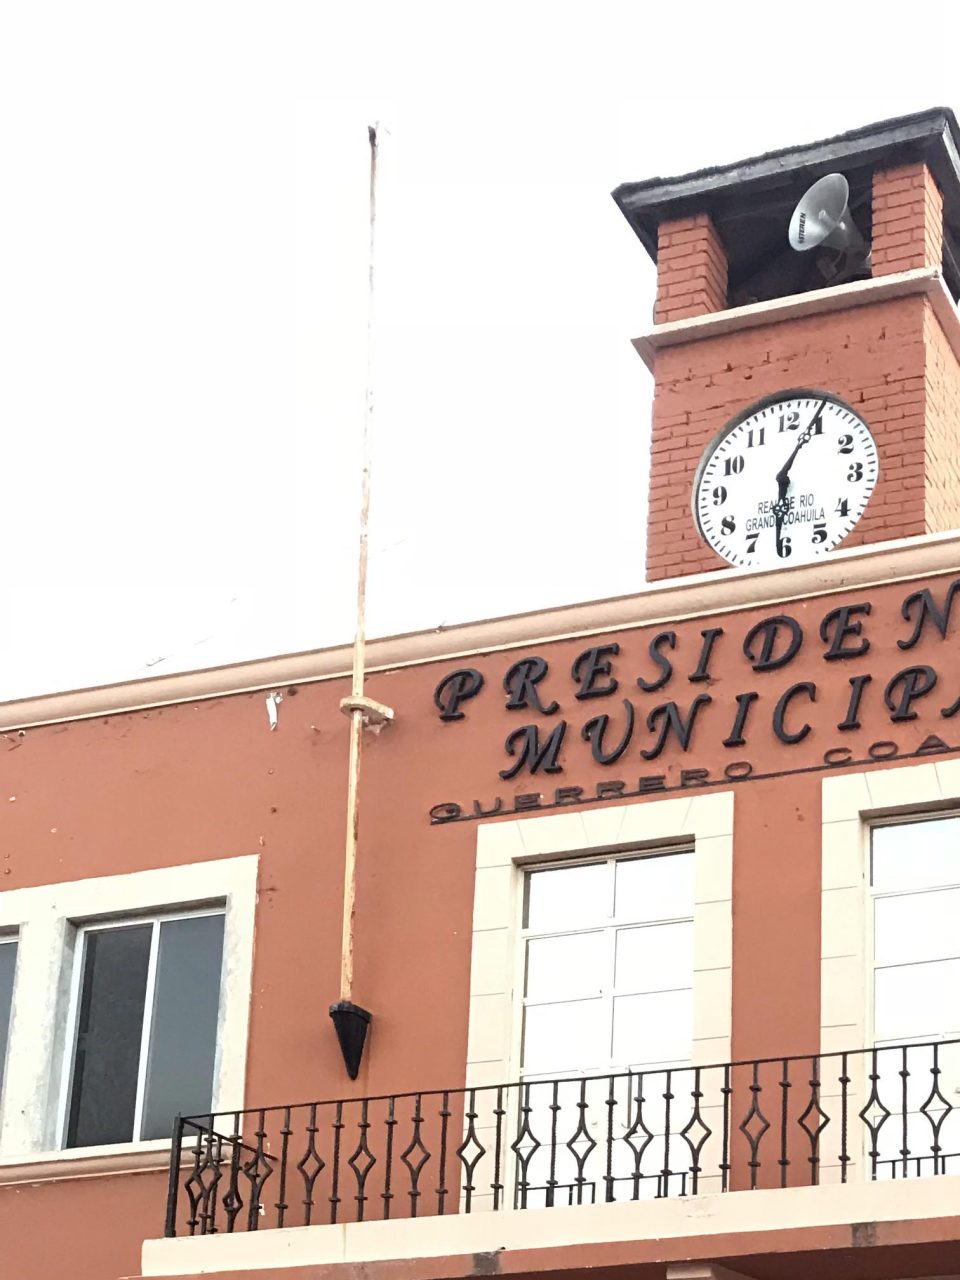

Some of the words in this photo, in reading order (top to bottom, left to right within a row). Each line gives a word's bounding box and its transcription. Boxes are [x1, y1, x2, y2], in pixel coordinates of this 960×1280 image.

[777, 411, 800, 433] 12
[811, 415, 825, 435] 1
[747, 427, 766, 448] 11
[837, 434, 854, 455] 2
[723, 455, 745, 476] 10
[847, 462, 863, 482] 3
[712, 486, 727, 506] 9
[799, 493, 814, 508] RIO
[834, 497, 851, 517] 4
[720, 515, 736, 536] 8
[745, 514, 780, 532] GRAND
[782, 507, 825, 525] COAHUILA
[745, 532, 760, 554] 7
[811, 522, 828, 544] 5
[776, 536, 792, 558] 6
[429, 761, 753, 823] GUERRERO
